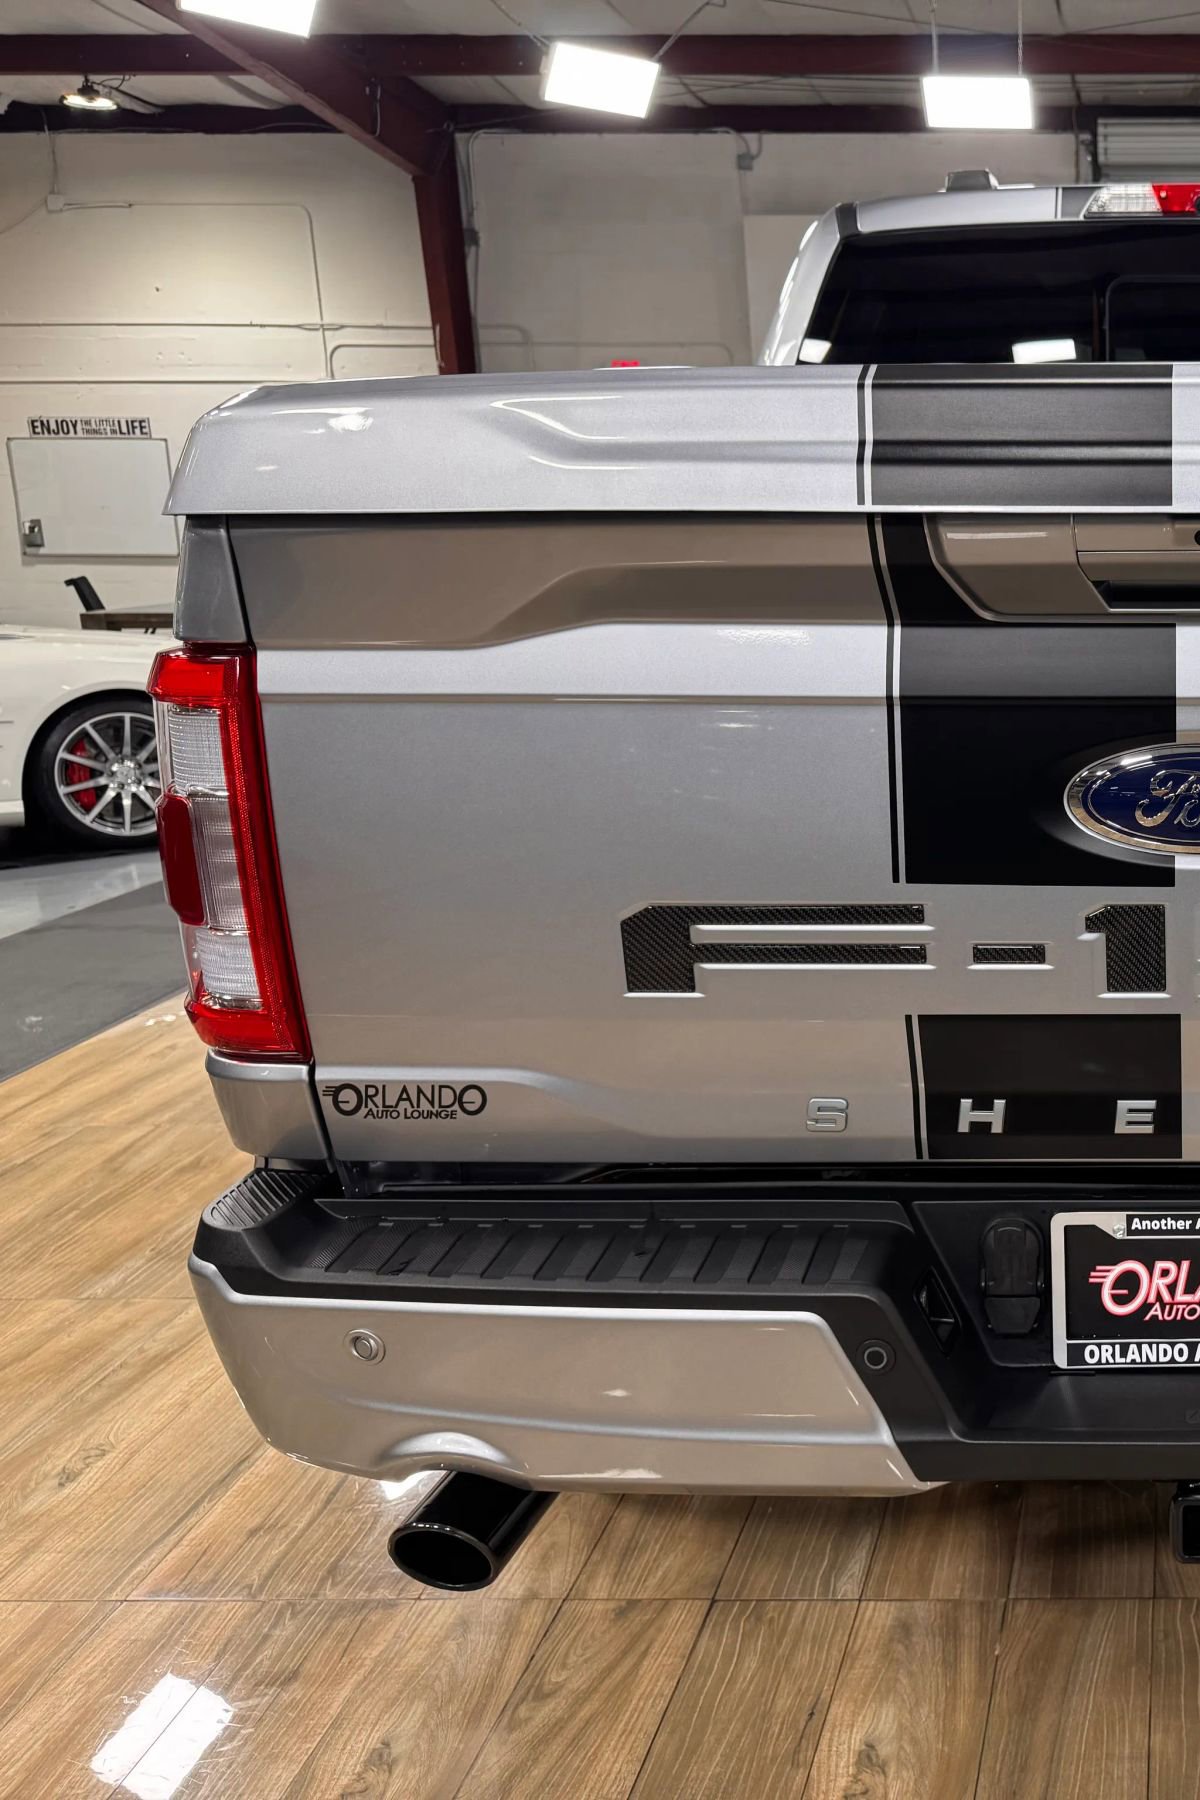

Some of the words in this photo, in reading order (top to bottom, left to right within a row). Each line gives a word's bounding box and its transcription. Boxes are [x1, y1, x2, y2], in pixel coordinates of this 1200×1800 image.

[30, 419, 78, 435] ENJOY
[80, 419, 92, 427] THE
[95, 419, 117, 427] LITTLE
[110, 427, 118, 435] IN
[118, 419, 148, 435] LIFE
[330, 1083, 488, 1116] ORLANDO
[364, 1107, 401, 1120] AUTO
[404, 1107, 458, 1120] LOUNGE
[1131, 1217, 1192, 1231] Another
[1144, 1301, 1200, 1321] AUTO
[1084, 1343, 1189, 1364] ORLANDO
